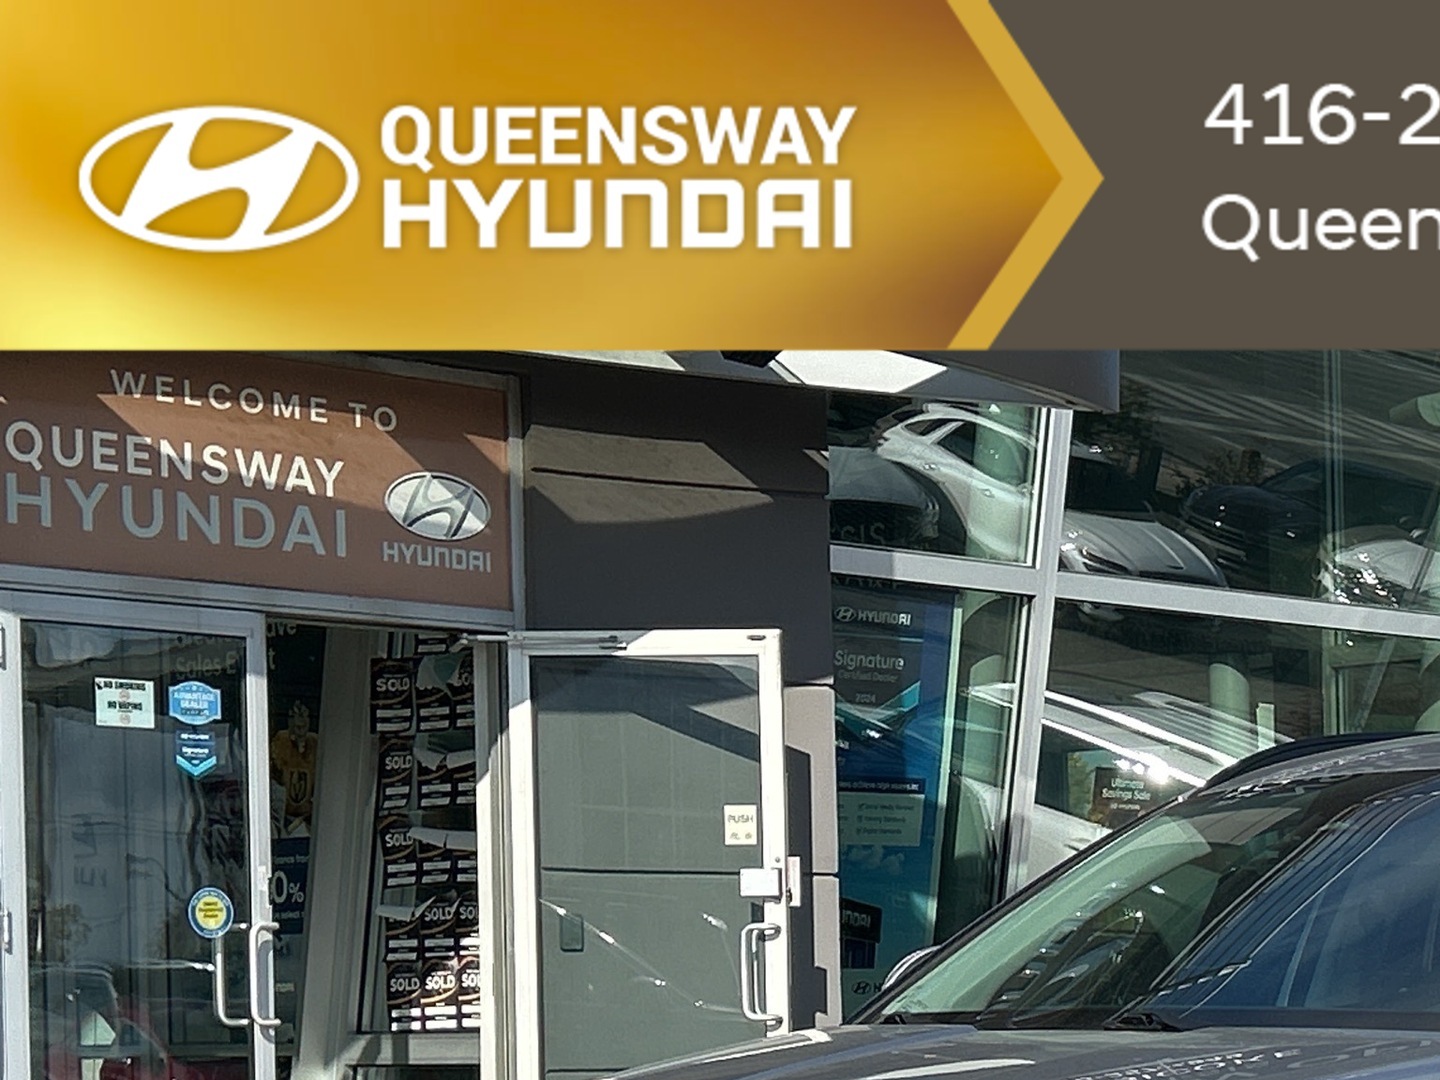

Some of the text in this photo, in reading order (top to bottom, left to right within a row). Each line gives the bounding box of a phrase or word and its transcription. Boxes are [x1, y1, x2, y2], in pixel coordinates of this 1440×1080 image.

[111, 368, 398, 432] WELCOME TO
[5, 420, 345, 498] QUEENSWAY
[5, 472, 347, 558] HYUNDAI
[383, 541, 492, 573] HYUNDAI
[858, 609, 911, 626] HYUNDAI
[834, 650, 905, 671] Signature
[375, 677, 410, 692] SOLD
[385, 756, 413, 770] SOLD
[389, 976, 420, 992] SOLD
[425, 975, 456, 990] SOLD
